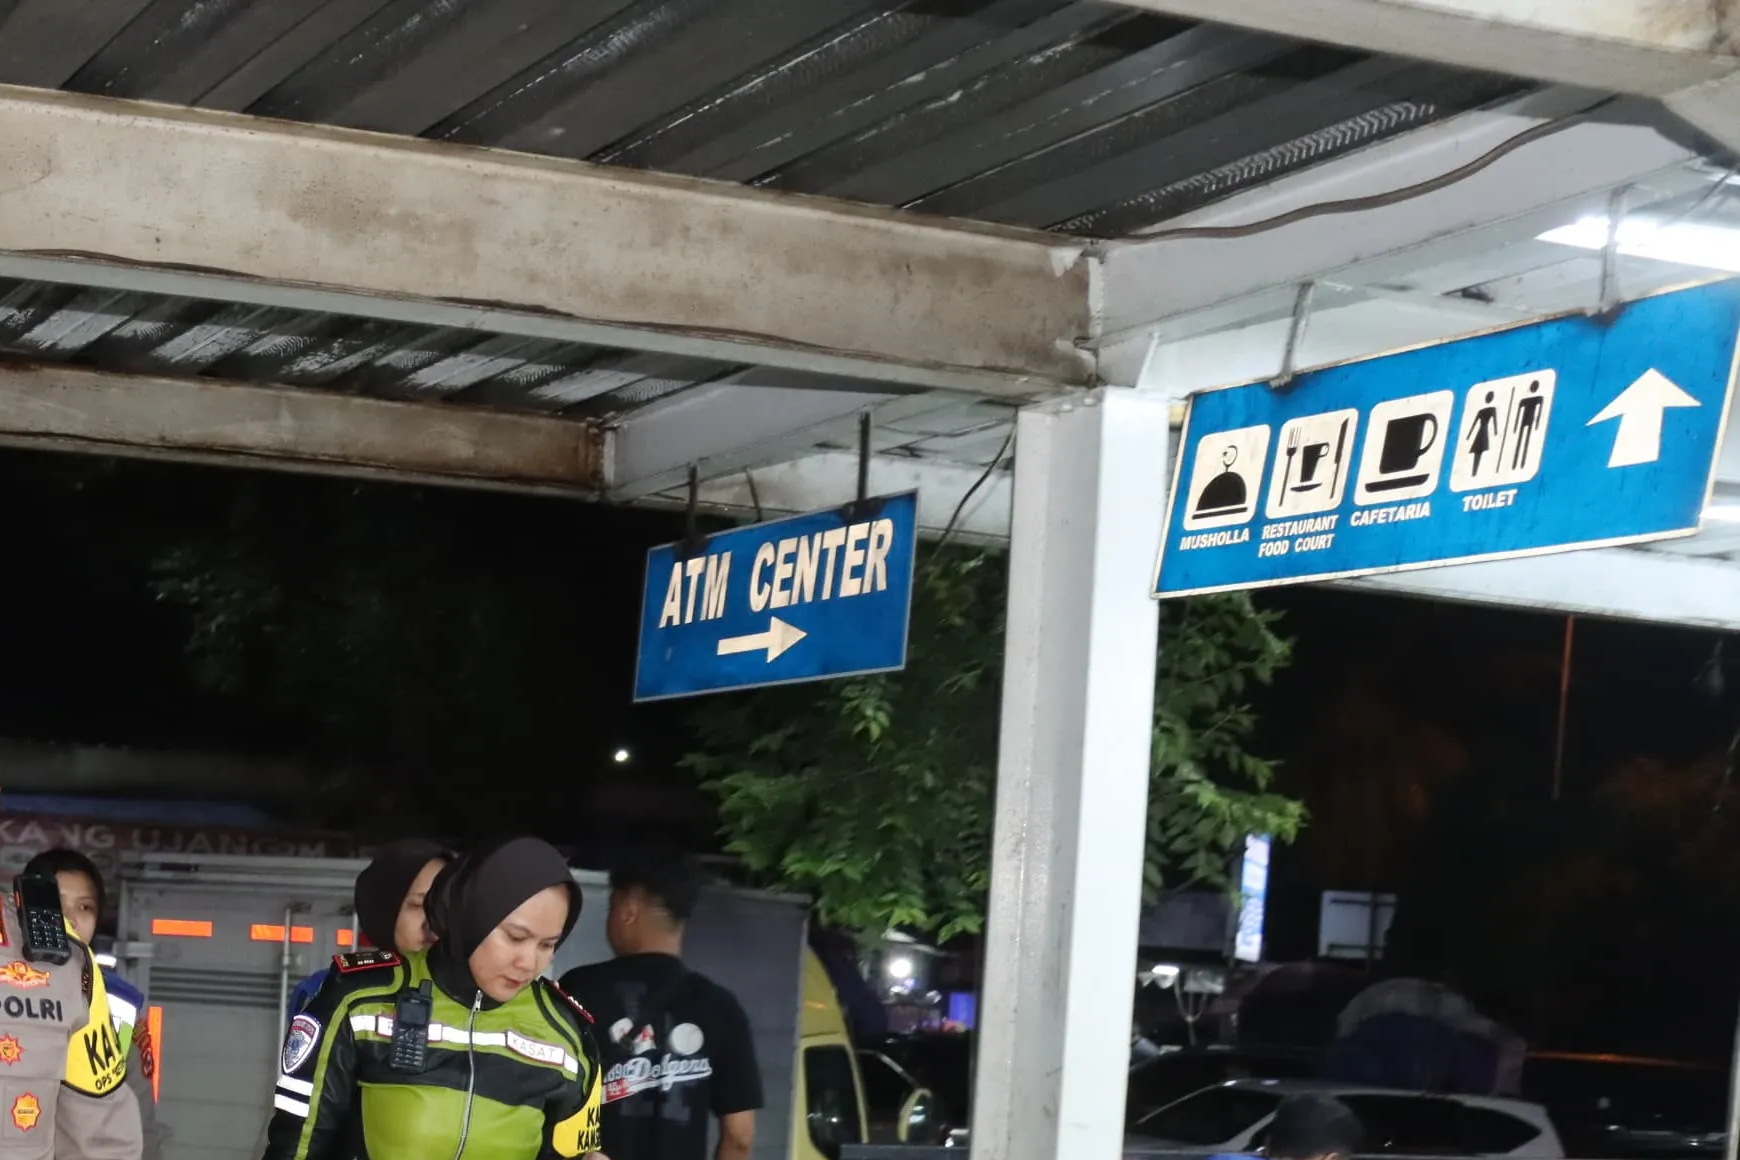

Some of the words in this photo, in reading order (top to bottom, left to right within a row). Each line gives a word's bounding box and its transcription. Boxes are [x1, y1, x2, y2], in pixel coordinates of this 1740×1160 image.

[1462, 489, 1518, 512] TOILET
[1350, 502, 1431, 527] CAFETARIA
[1262, 515, 1339, 540] RESTAURANT
[1179, 529, 1251, 551] MUSHOLLA
[1258, 541, 1289, 558] FOOD
[1294, 534, 1335, 553] COURT
[658, 552, 732, 629] ATM
[749, 518, 894, 613] CENTER
